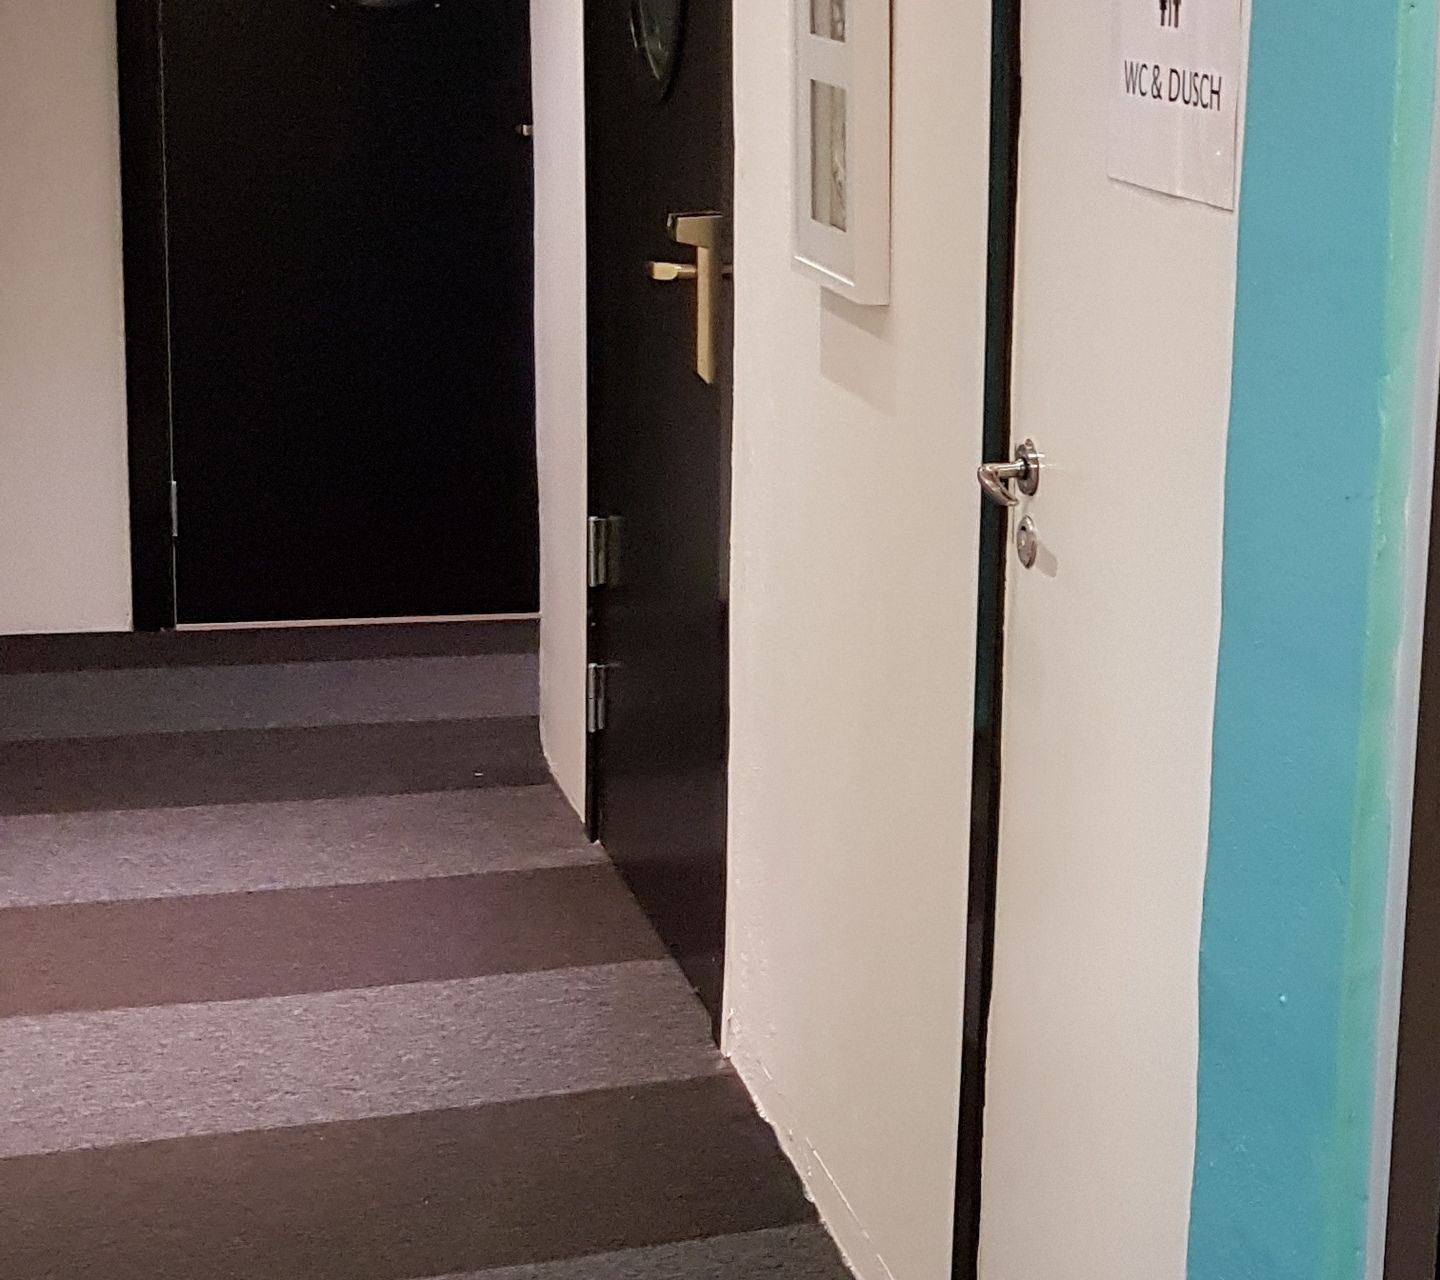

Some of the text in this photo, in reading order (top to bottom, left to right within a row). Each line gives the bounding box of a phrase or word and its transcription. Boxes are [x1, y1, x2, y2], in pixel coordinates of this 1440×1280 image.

[1123, 59, 1223, 112] WC & DUSCH
